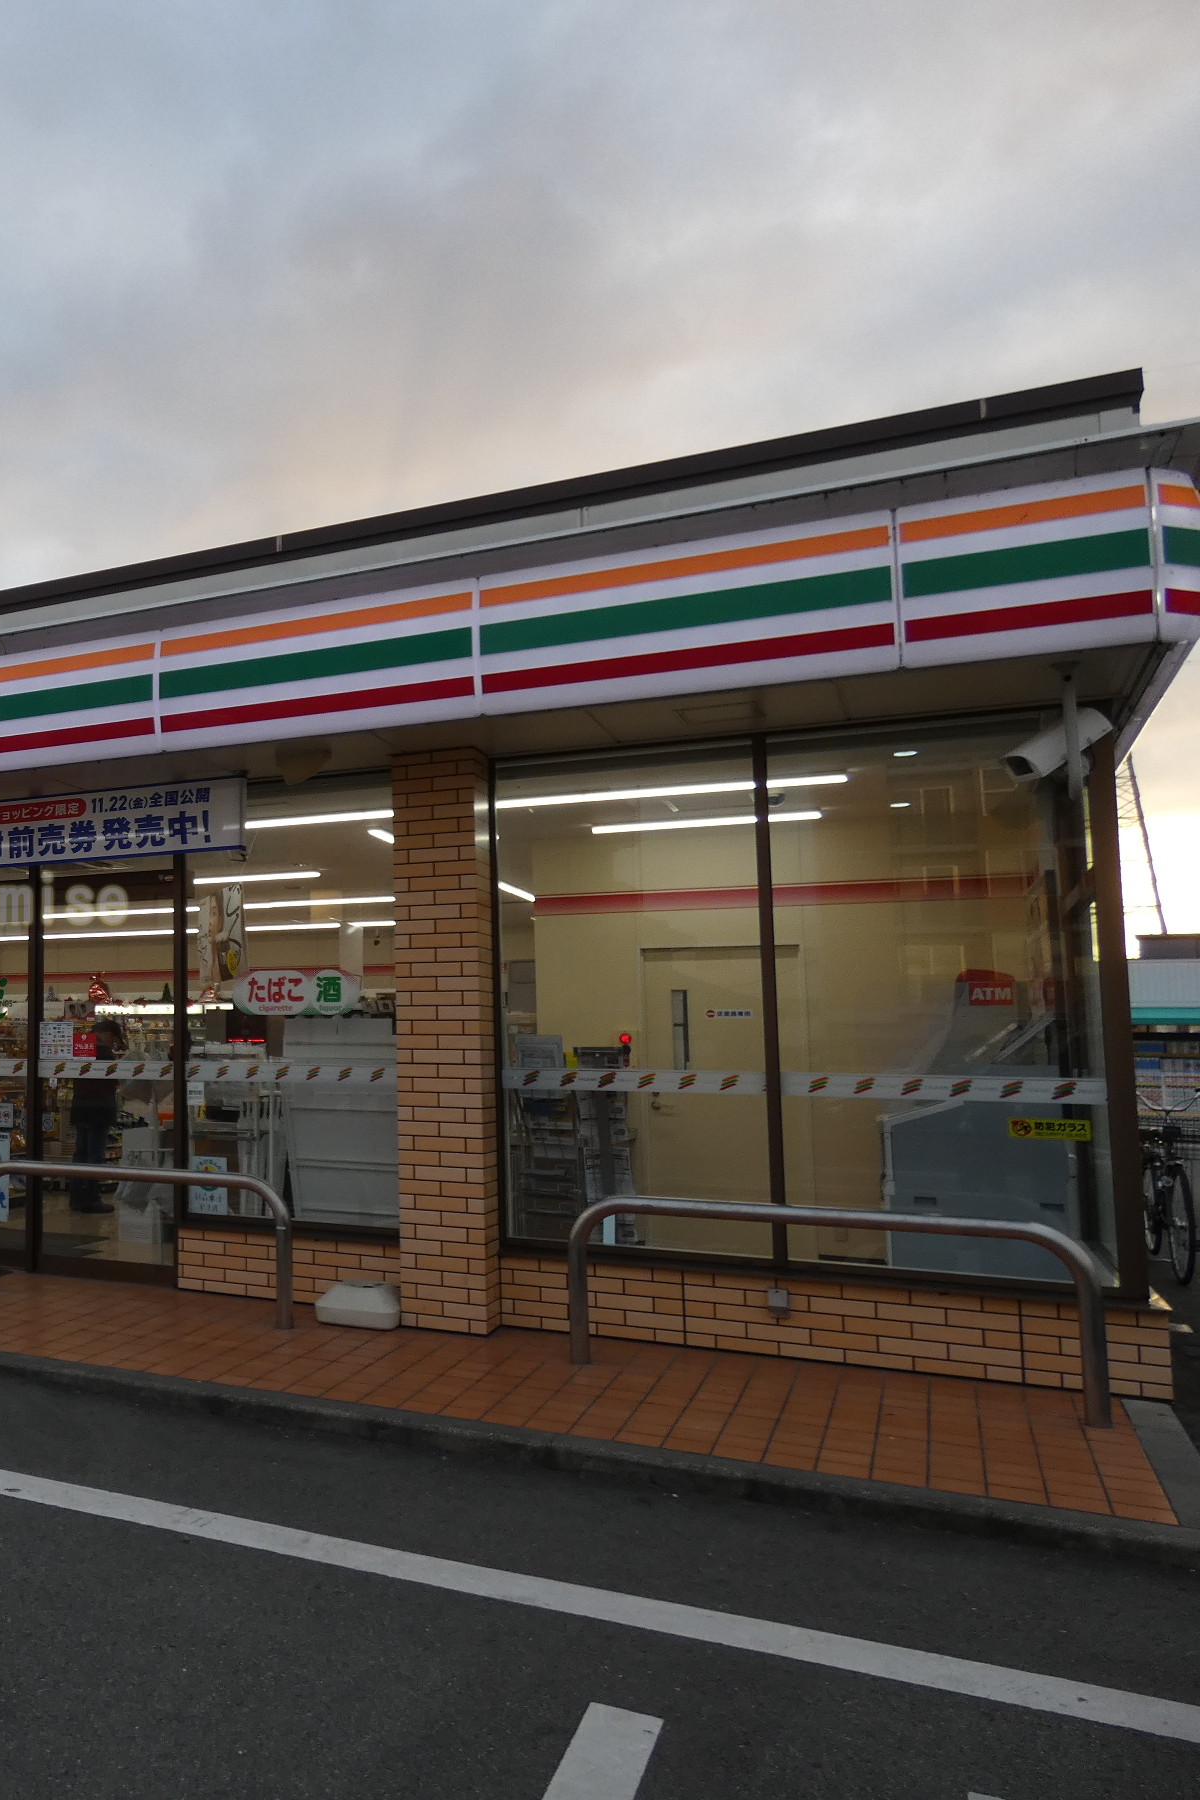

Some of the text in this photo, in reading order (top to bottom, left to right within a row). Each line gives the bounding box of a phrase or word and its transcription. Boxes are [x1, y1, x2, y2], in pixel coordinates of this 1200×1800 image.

[248, 976, 341, 1003] たばこ 酒
[972, 987, 1012, 1001] ATM
[258, 1004, 294, 1012] cigarette
